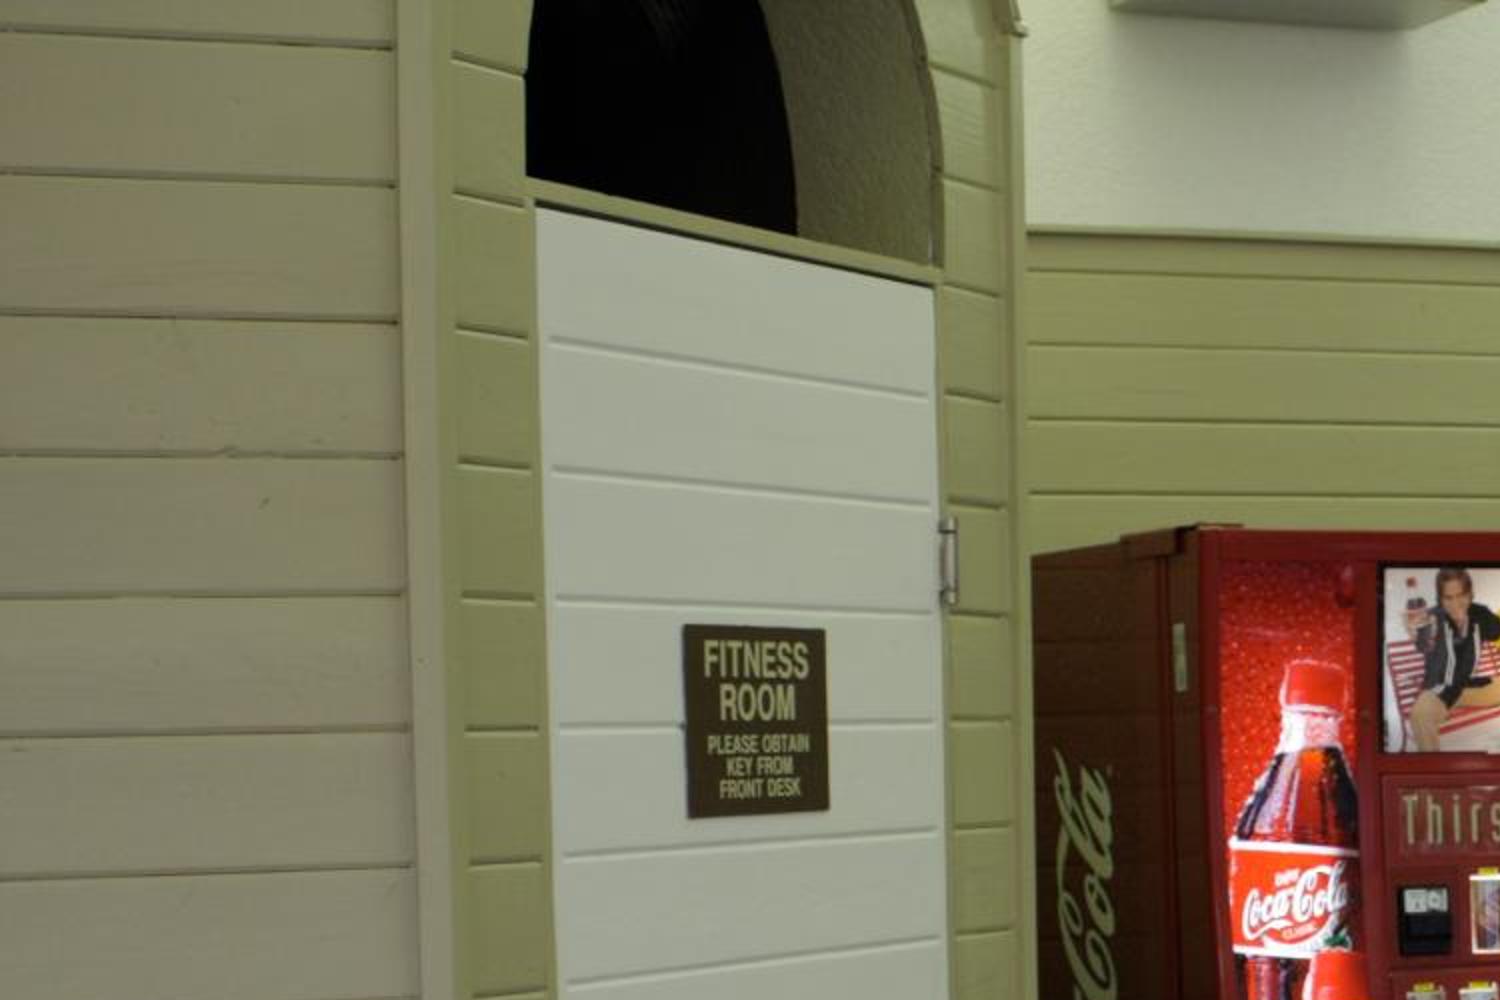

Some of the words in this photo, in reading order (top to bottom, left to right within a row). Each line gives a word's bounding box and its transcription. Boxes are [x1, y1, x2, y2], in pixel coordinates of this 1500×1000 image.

[703, 639, 810, 679] FITNESS
[719, 683, 796, 721] ROOM
[707, 735, 759, 755] PLEASE
[761, 733, 810, 753] OBTAIN
[726, 756, 753, 776] KEY
[756, 755, 794, 775] FROM
[719, 779, 764, 799] FRONT
[767, 777, 802, 797] DESK
[1242, 860, 1347, 941] Coca-Cola
